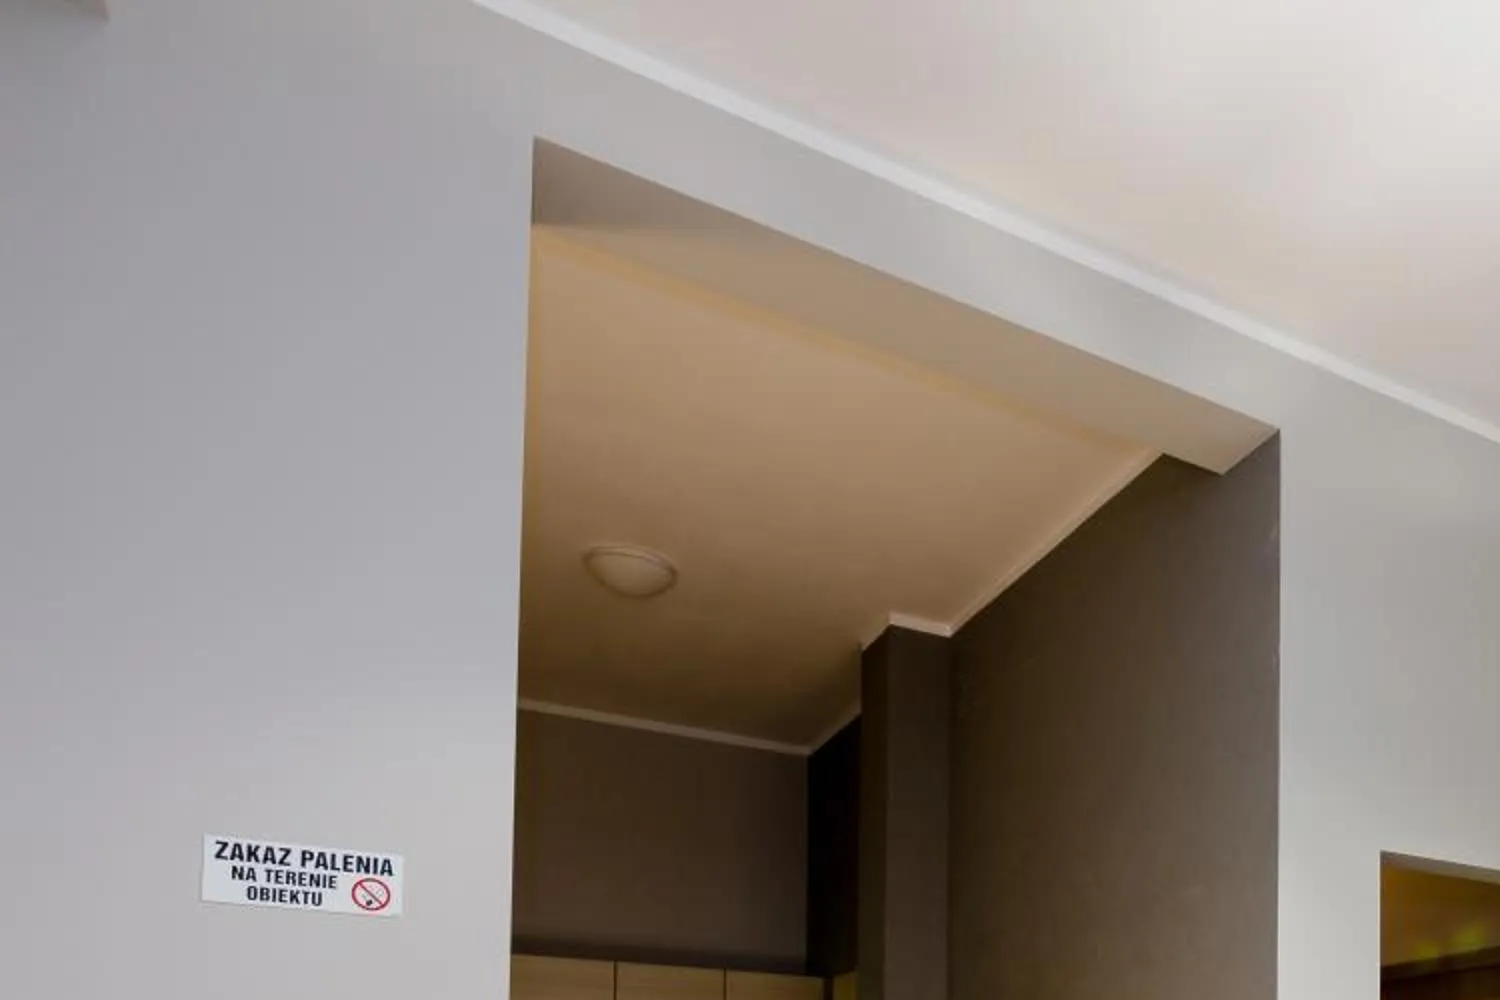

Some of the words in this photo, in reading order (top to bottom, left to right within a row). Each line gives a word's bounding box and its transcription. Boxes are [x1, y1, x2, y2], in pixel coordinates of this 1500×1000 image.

[214, 840, 292, 866] ZAKAZ
[301, 849, 394, 877] PALENIA
[231, 865, 257, 882] NA
[265, 868, 338, 889] TERENIE
[246, 885, 323, 906] OBIEKTU
